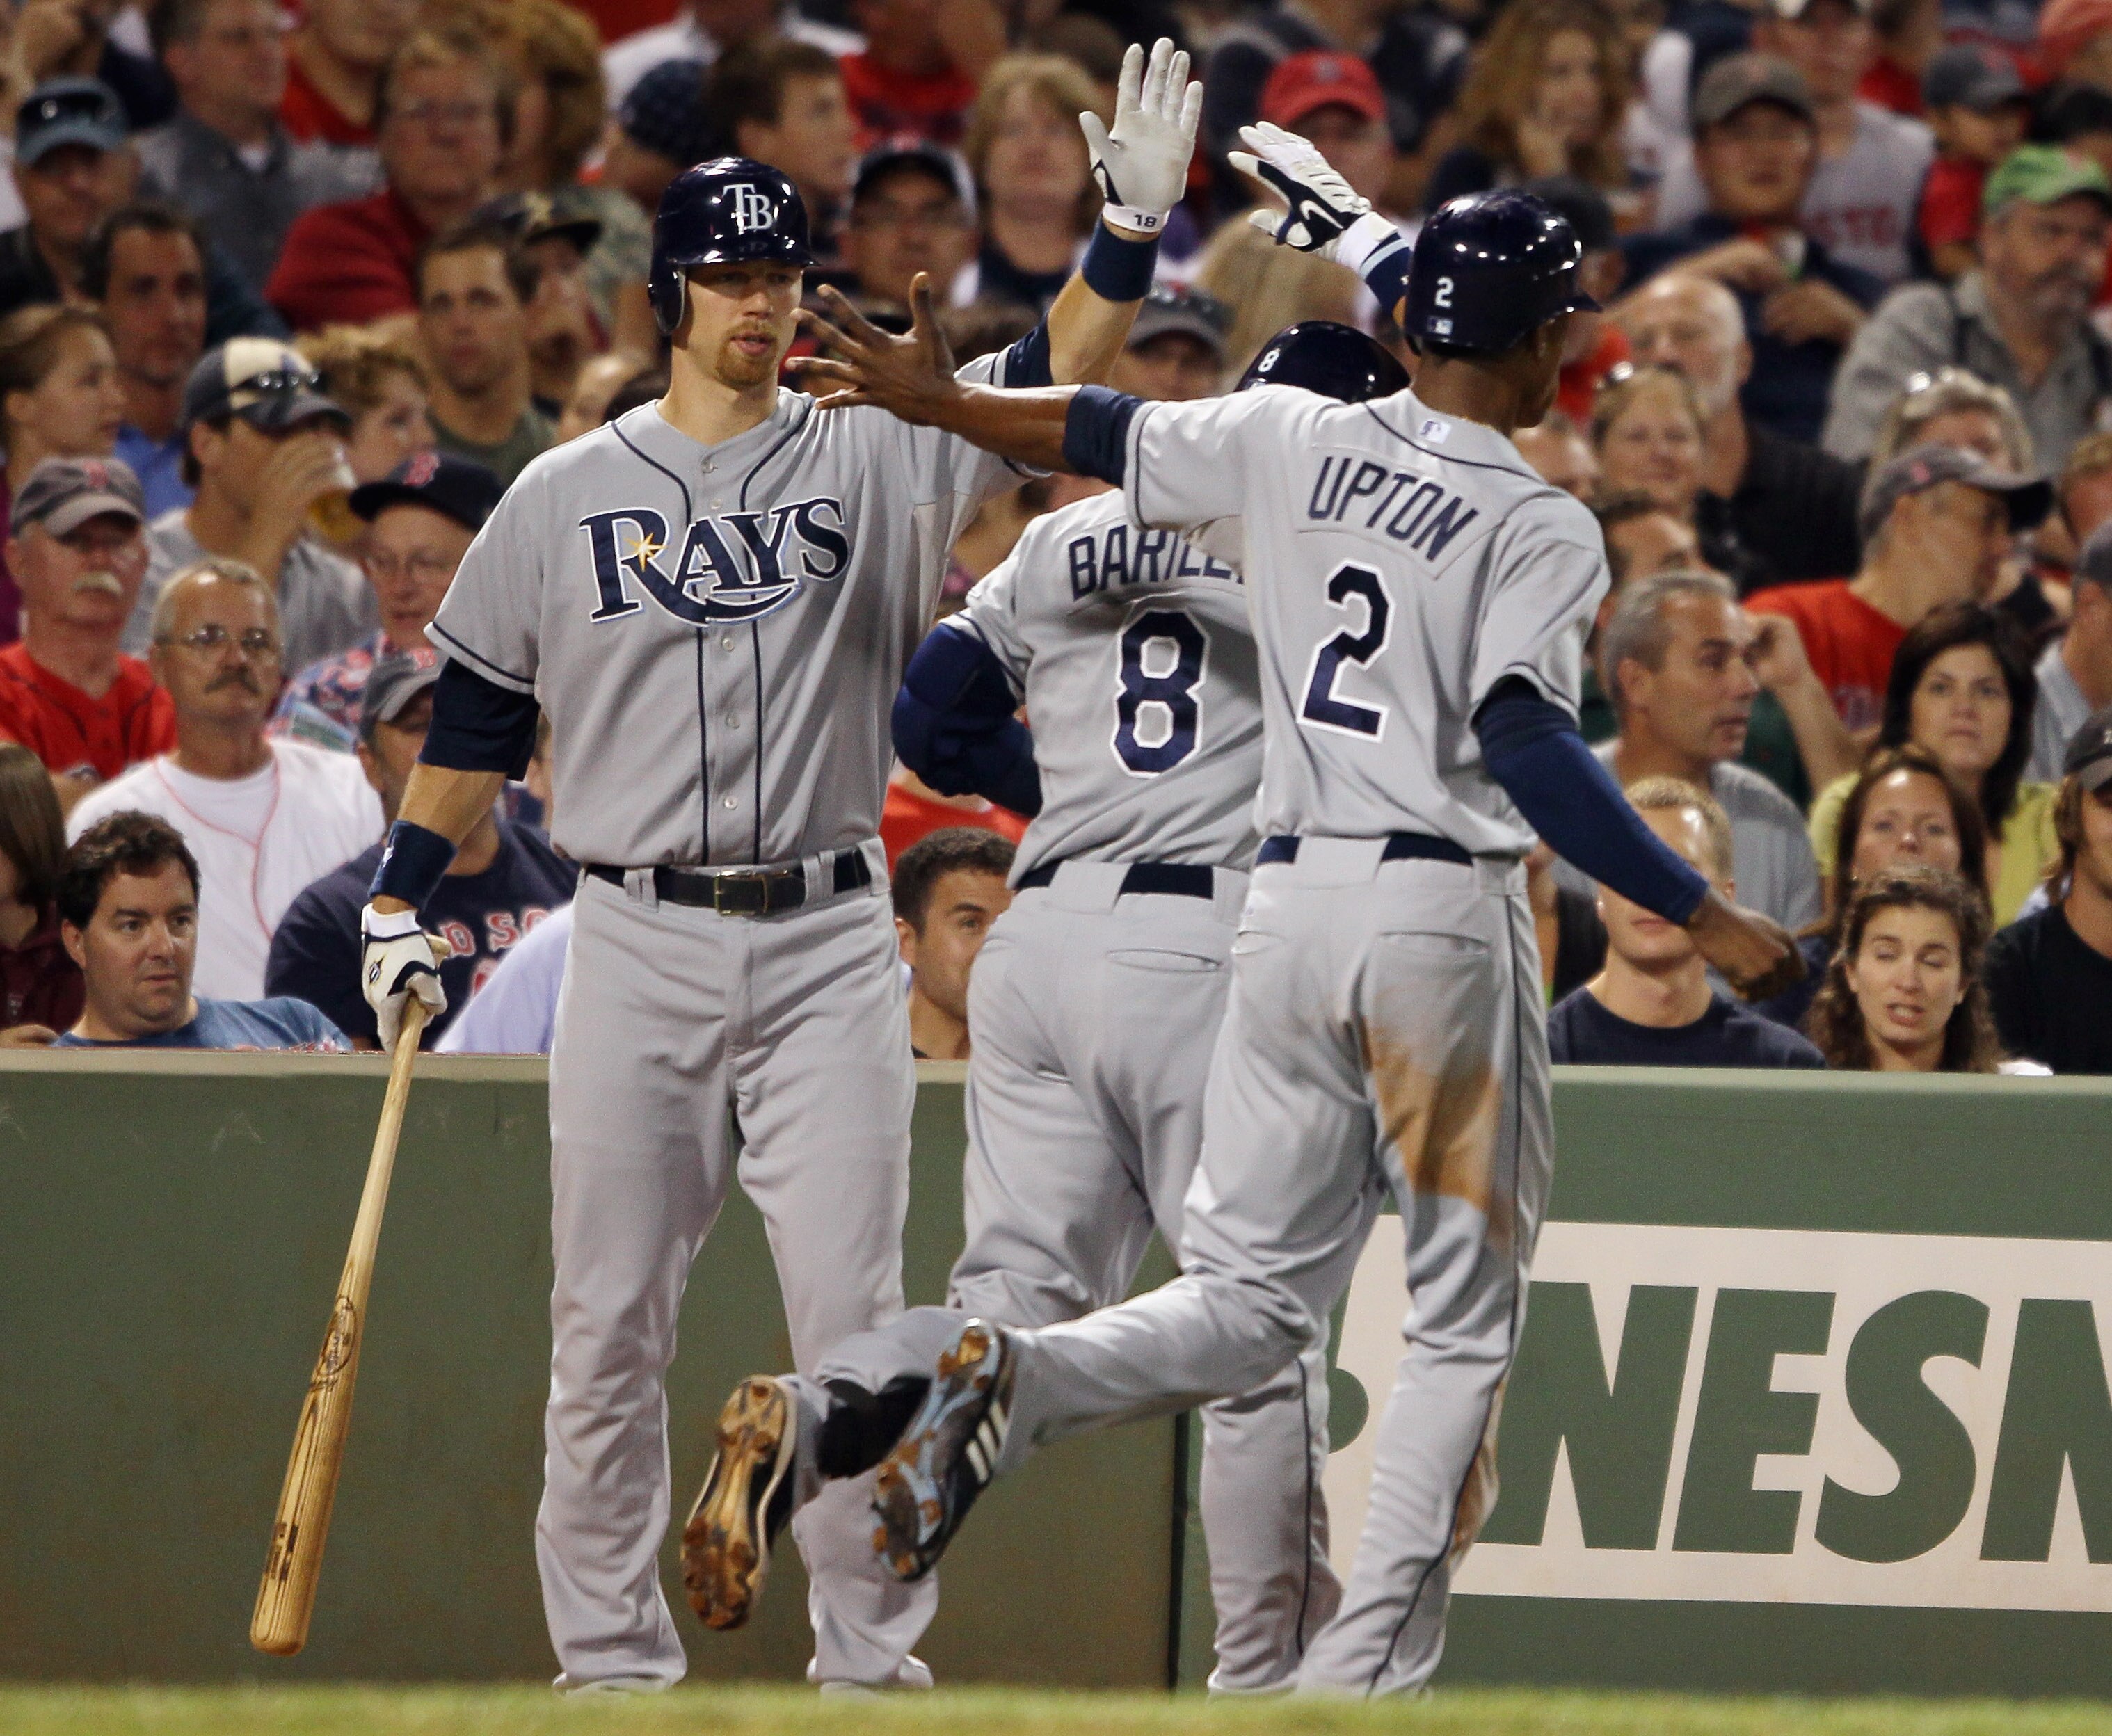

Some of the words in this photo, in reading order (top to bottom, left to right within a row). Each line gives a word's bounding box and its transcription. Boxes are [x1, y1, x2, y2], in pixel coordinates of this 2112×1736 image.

[722, 184, 773, 234] TB
[1134, 214, 1157, 227] 18
[1435, 276, 1454, 307] 2
[1258, 348, 1281, 372] 8
[579, 495, 849, 627] RAYS
[1308, 456, 1479, 562] UPTON
[1110, 607, 1211, 779] 8
[1297, 559, 1397, 743] 2
[1473, 1281, 2112, 1564] NESN
